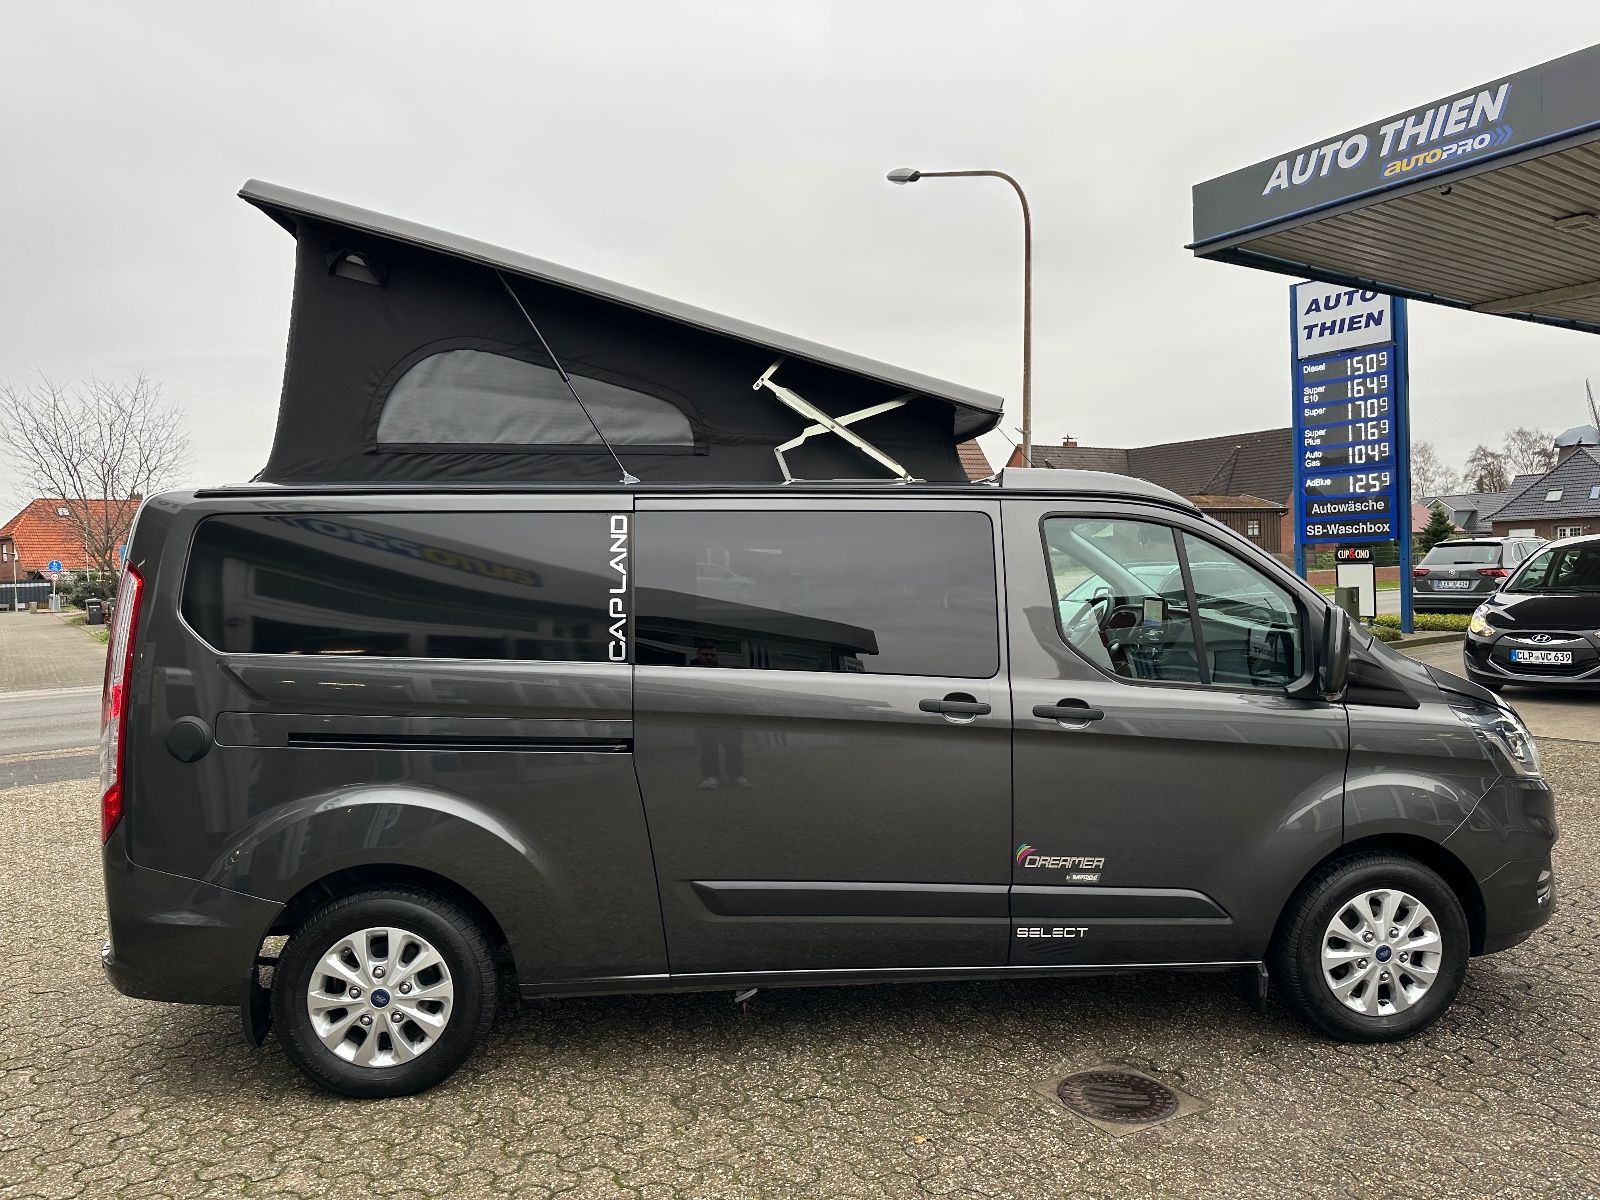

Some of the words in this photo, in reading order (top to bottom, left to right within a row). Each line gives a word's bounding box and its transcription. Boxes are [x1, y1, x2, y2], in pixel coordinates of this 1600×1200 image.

[1262, 134, 1369, 195] AUTO
[1379, 83, 1510, 157] THIEN
[1304, 289, 1378, 315] AUTO
[1303, 310, 1384, 340] THIEN
[1303, 363, 1325, 374] Diesel
[1304, 385, 1326, 395] Super
[1304, 395, 1319, 404] E10
[1304, 407, 1326, 417] Super
[1304, 428, 1327, 438] Super
[1304, 438, 1321, 447] Plus
[1305, 451, 1323, 459] Auto
[1305, 459, 1321, 467] Gas
[1306, 478, 1331, 488] AdBlue
[1311, 500, 1385, 514] Autowäsche
[1306, 522, 1390, 536] SB-Waschbox
[608, 515, 628, 661] CAPLAND
[1517, 651, 1533, 661] CLP
[1540, 652, 1552, 661] VC
[1553, 652, 1571, 662] 639
[1025, 856, 1104, 868] DREAMER
[1017, 927, 1088, 938] SELECT
